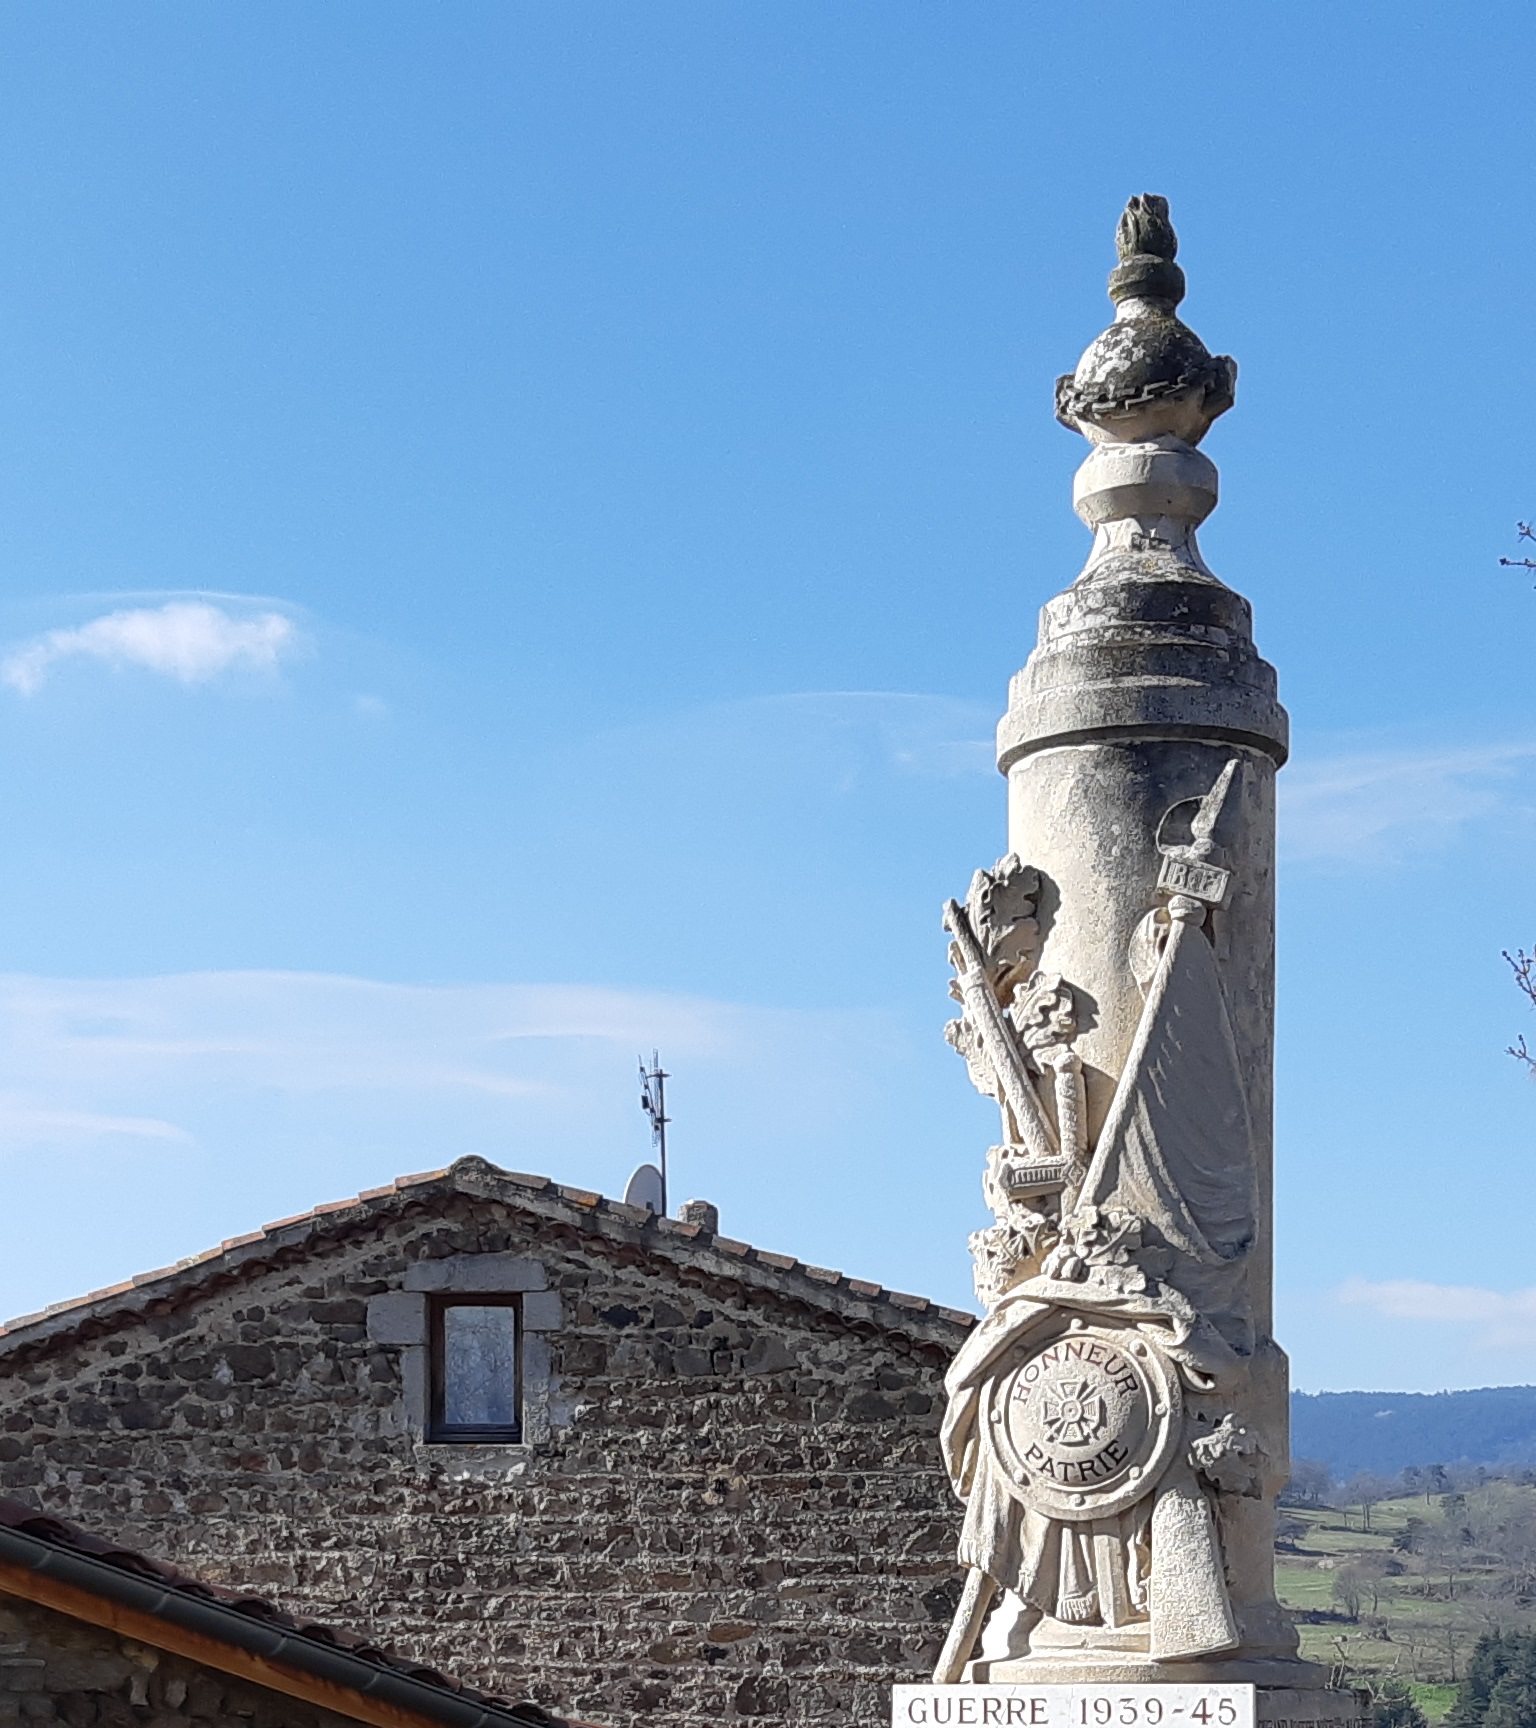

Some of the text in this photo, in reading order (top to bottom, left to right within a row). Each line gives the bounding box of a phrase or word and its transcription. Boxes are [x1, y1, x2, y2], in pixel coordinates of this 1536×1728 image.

[1013, 1342, 1139, 1405] HONNEUR
[1024, 1440, 1129, 1481] PATRIE
[908, 1697, 1237, 1726] GUERRE 1939-45
